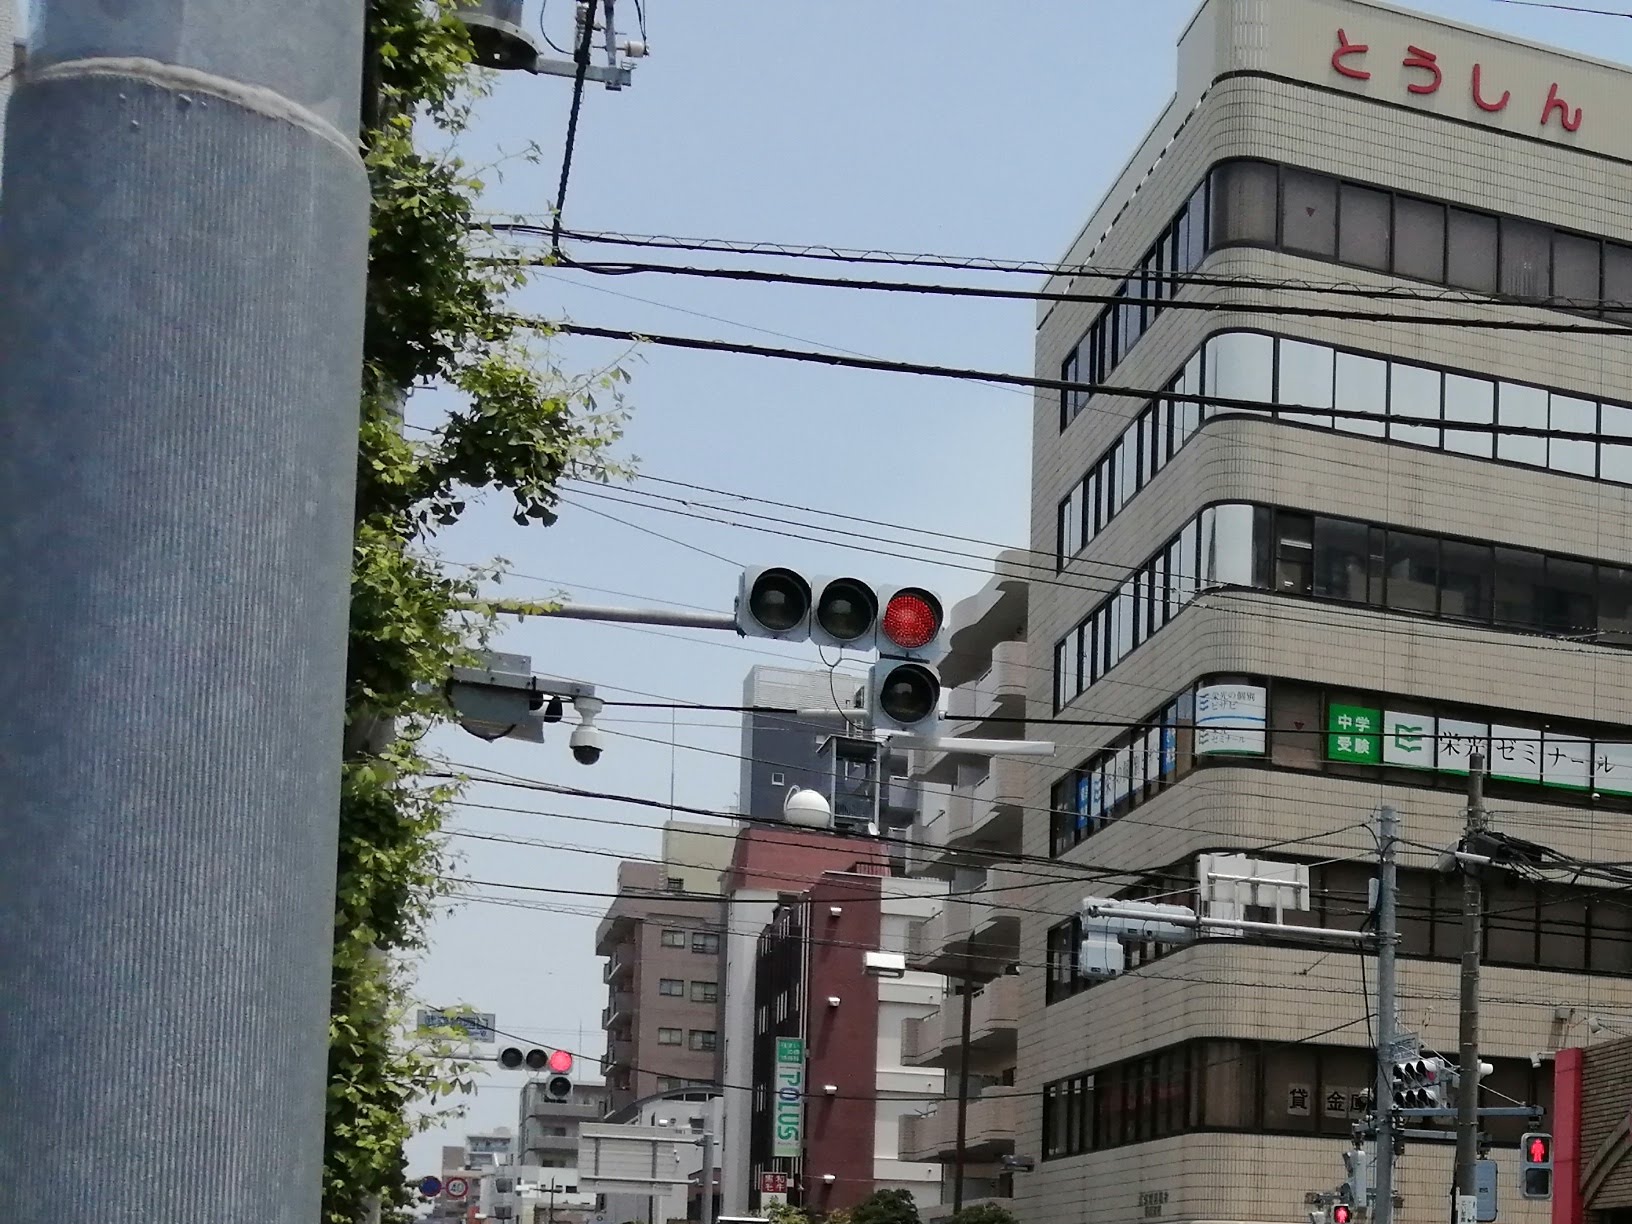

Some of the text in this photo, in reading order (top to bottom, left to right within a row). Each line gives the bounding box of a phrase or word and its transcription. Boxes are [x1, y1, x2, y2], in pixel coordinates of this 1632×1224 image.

[1331, 27, 1583, 132] とうしん
[1337, 714, 1370, 732] 中学
[1337, 735, 1370, 755] 受験
[1439, 731, 1614, 774] 栄光ゼミナール
[777, 1071, 801, 1141] POLUS
